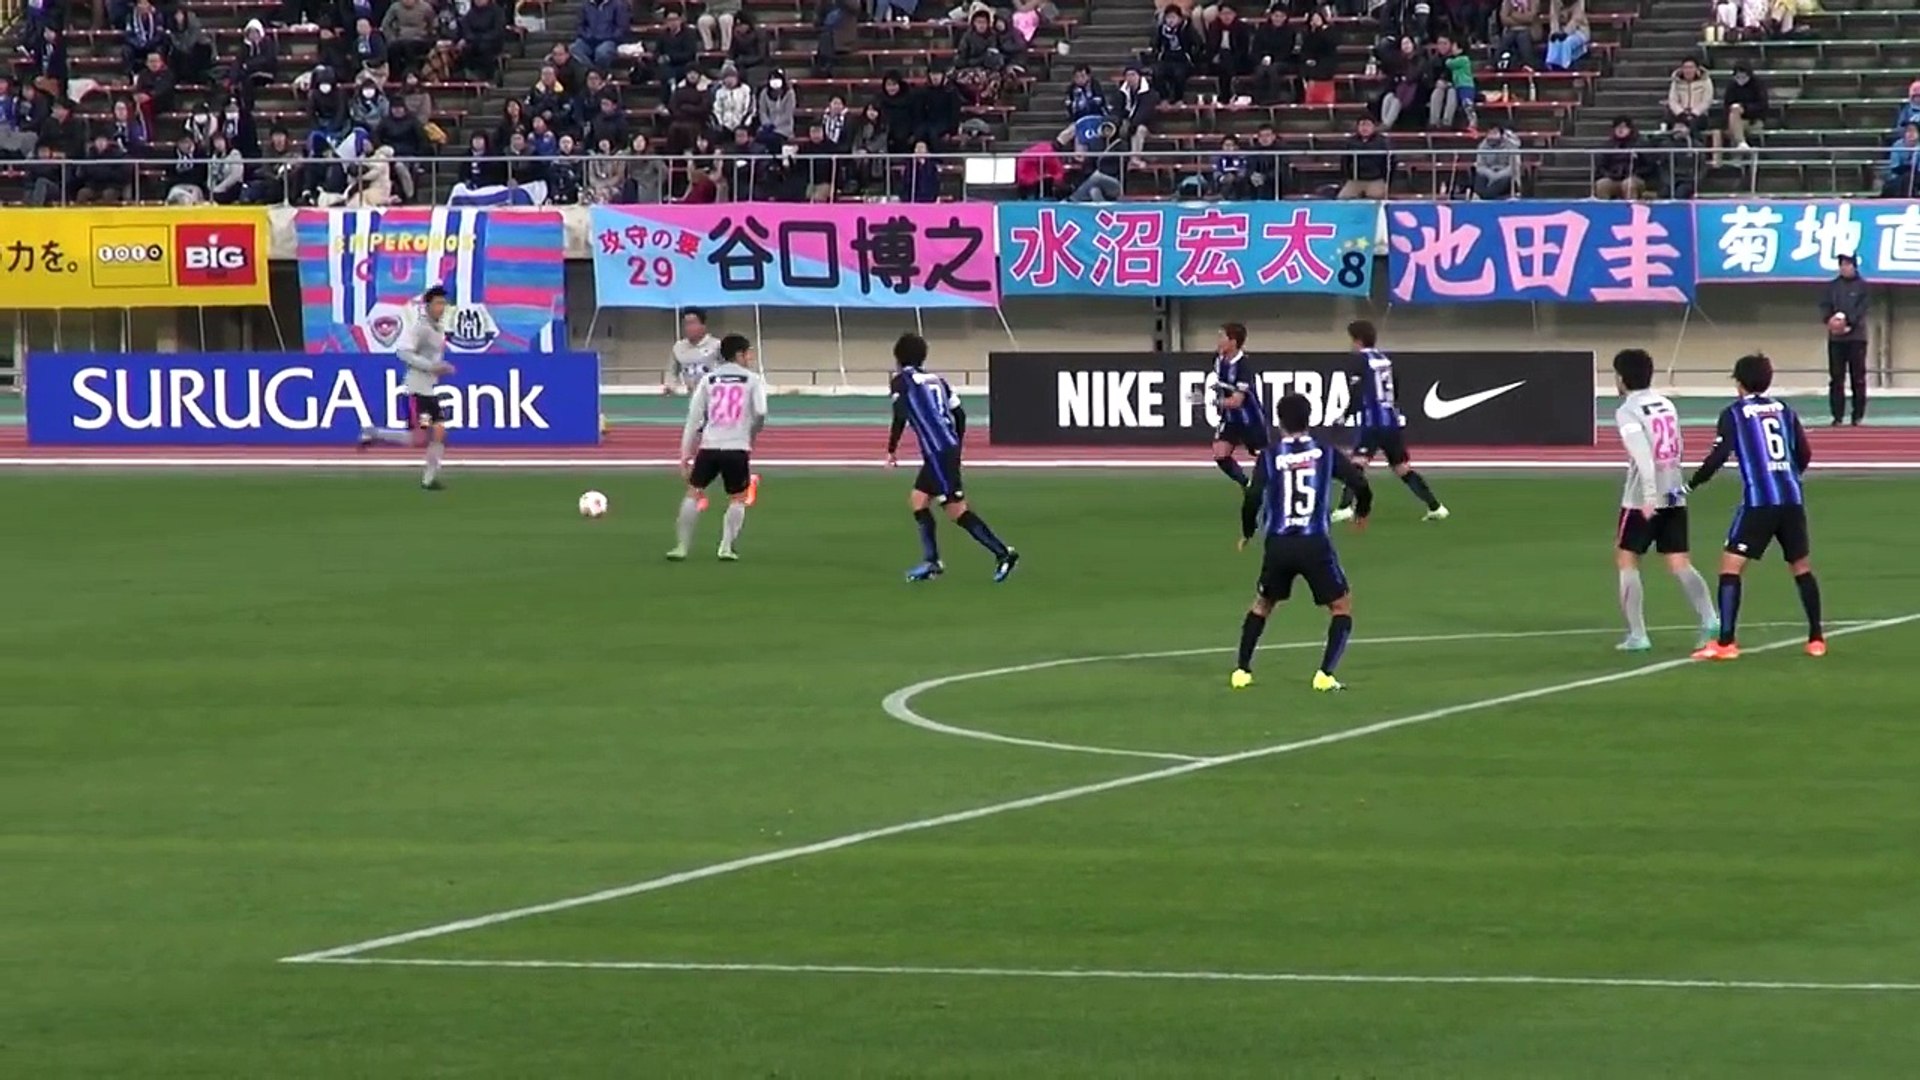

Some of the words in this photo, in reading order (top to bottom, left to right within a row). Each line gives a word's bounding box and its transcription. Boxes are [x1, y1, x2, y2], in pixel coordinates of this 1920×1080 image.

[0, 240, 79, 273] 力を。
[598, 224, 702, 260] 攻守の要
[707, 215, 992, 294] 谷口博之
[1010, 208, 1337, 289] 水沼宏太
[1390, 204, 1689, 303] 池田圭
[356, 254, 456, 283] CUP
[627, 255, 673, 287] 29
[1337, 250, 1367, 289] 8
[72, 366, 373, 430] SURUGA
[711, 384, 744, 426] 28
[1057, 371, 1164, 428] NIKE
[1762, 419, 1785, 459] 6
[1283, 469, 1316, 517] 15
